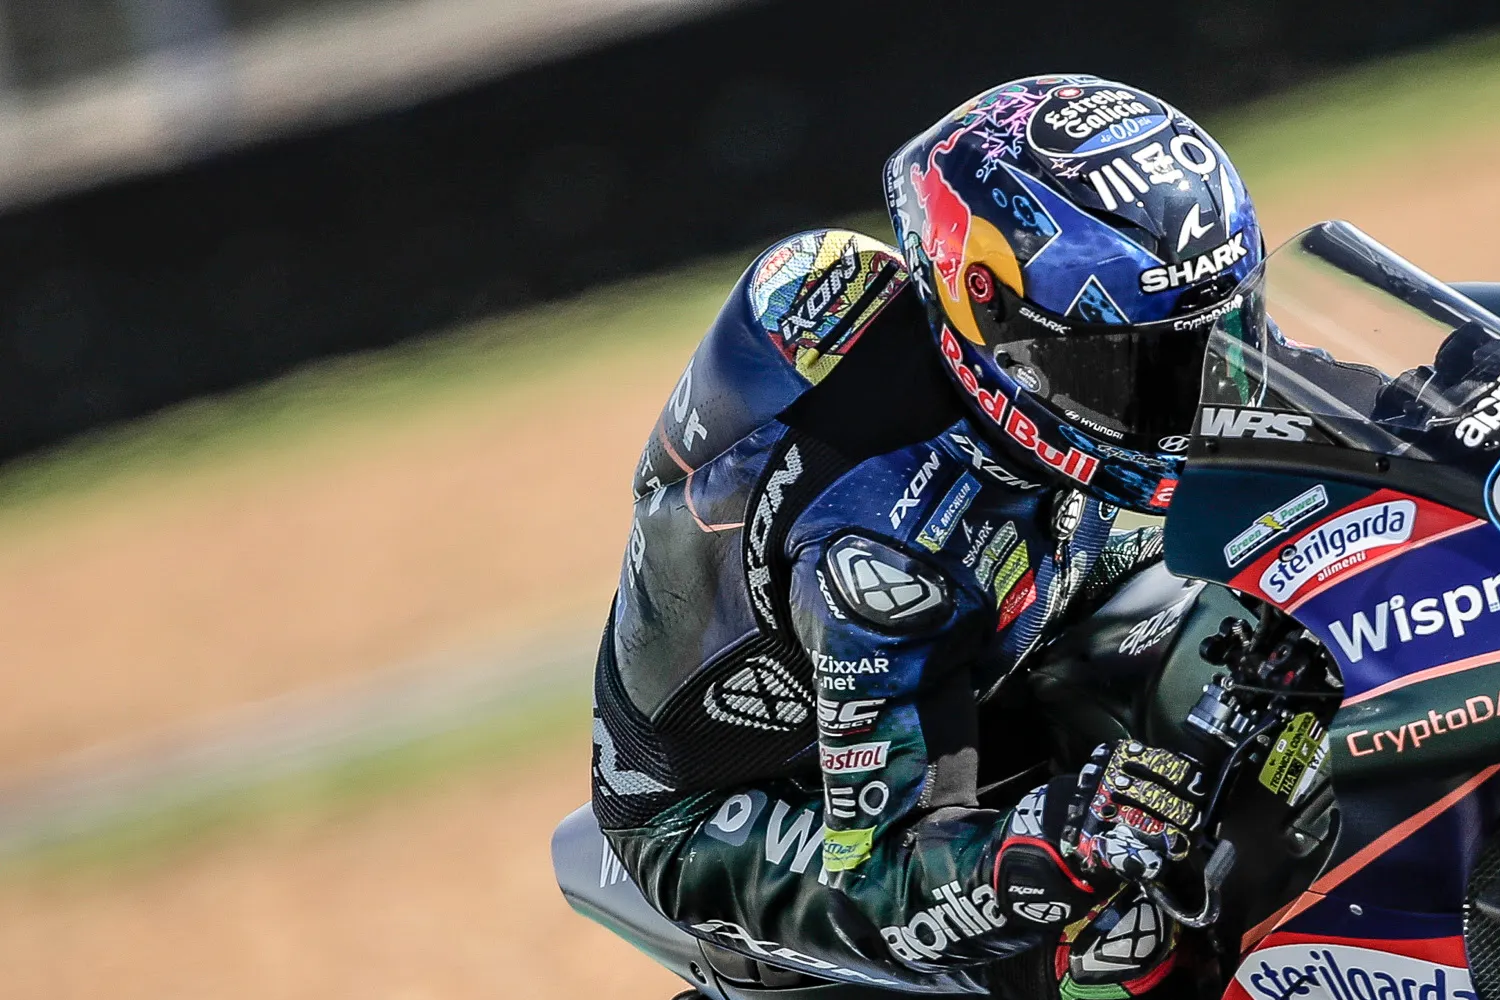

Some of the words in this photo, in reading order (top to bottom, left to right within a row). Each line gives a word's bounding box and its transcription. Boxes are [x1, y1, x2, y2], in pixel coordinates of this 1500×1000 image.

[1044, 89, 1136, 131] Estrella
[1065, 101, 1150, 138] Galicia
[1141, 233, 1247, 293] SHARK
[1018, 307, 1069, 335] SHARK
[939, 324, 1009, 426] Red
[1005, 406, 1099, 485] Bull
[1080, 417, 1124, 440] HYUNDAI
[1202, 406, 1313, 442] WRS
[950, 433, 1042, 490] IXON
[889, 450, 941, 530] IXON
[962, 520, 994, 568] SHARK
[1230, 529, 1262, 557] Green
[1279, 493, 1318, 521] Power
[1269, 505, 1406, 593] sterilgarda
[1317, 551, 1367, 582] alimenti
[815, 569, 847, 619] IXON
[818, 698, 887, 722] SC
[1008, 885, 1046, 896] IXON
[880, 880, 1008, 960] aprilia
